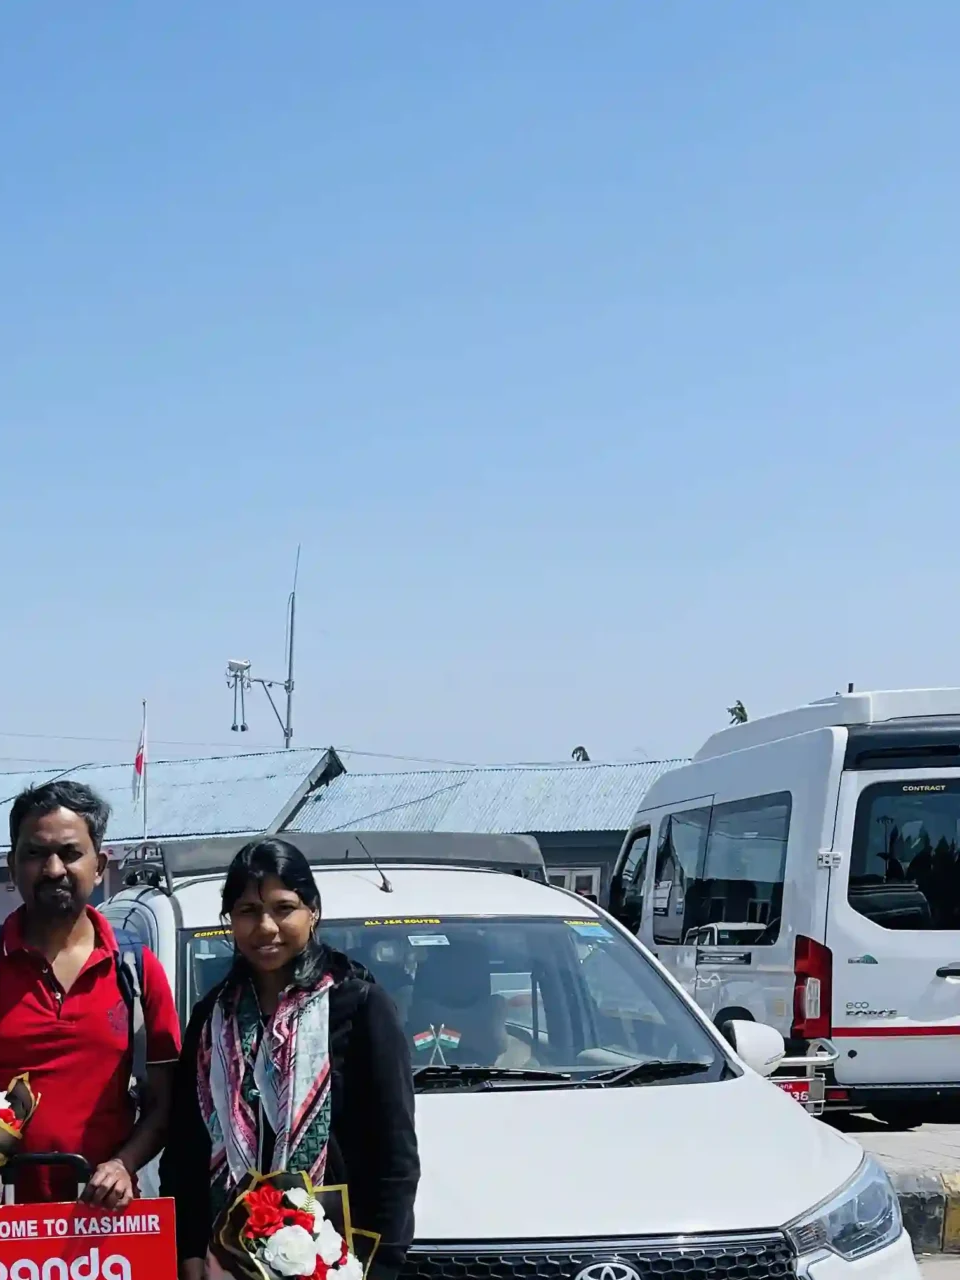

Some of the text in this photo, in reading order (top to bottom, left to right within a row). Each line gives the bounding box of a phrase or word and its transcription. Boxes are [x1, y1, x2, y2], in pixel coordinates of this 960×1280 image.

[194, 929, 233, 937] CONTRA
[43, 1218, 68, 1236] TO
[74, 1214, 160, 1234] KASHMIR
